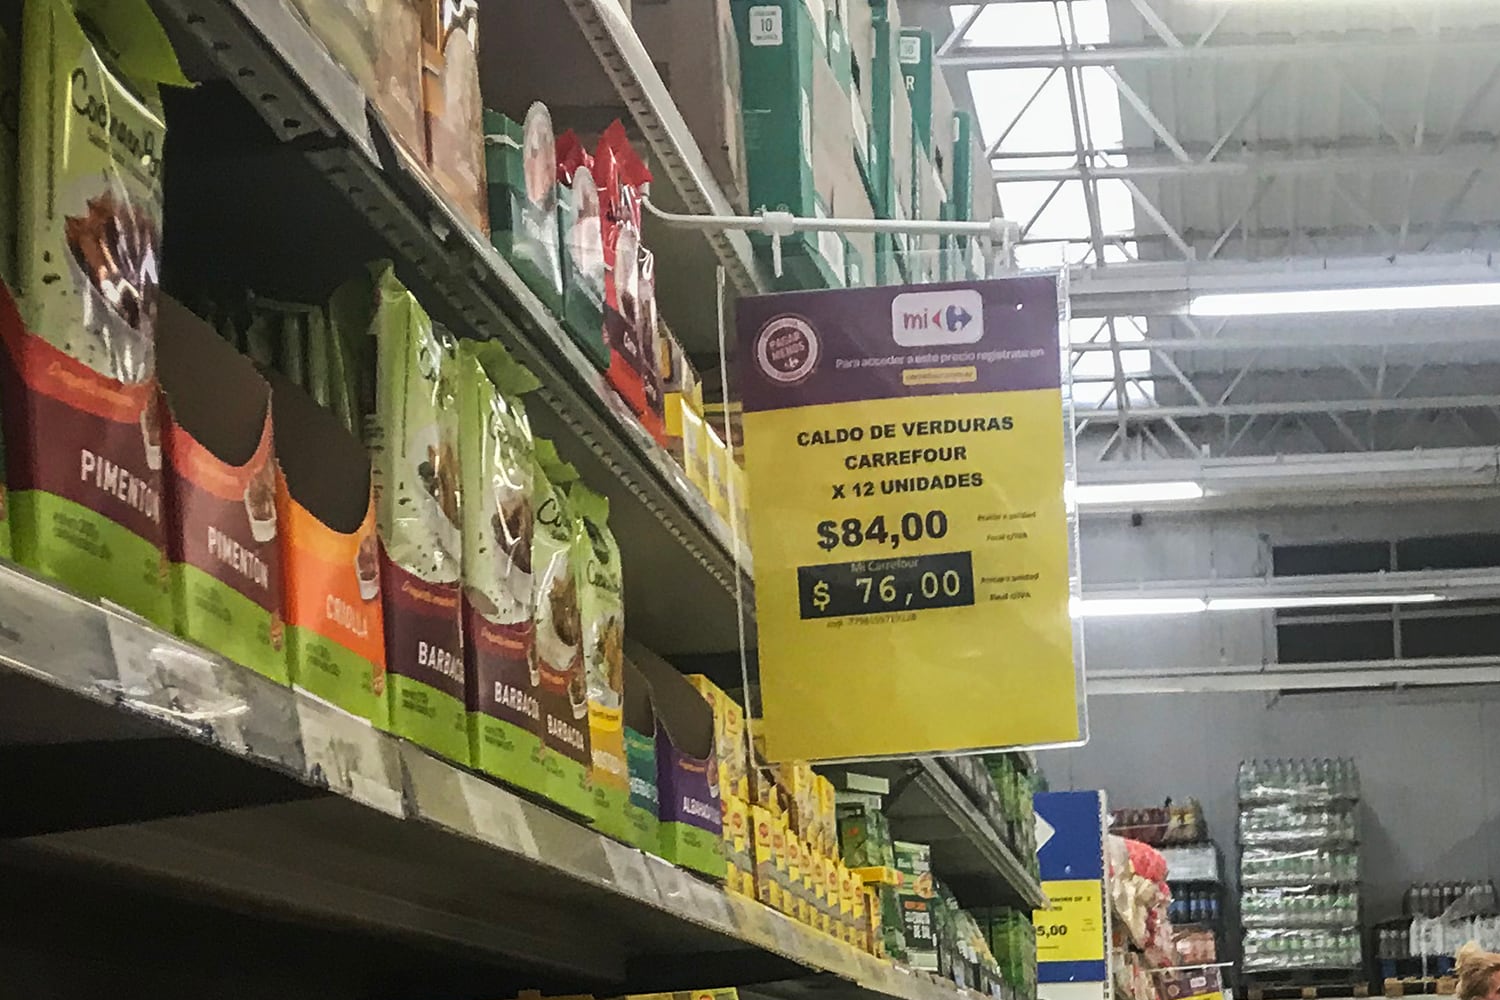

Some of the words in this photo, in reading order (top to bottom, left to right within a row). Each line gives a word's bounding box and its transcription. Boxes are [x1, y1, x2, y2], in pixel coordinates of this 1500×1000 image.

[761, 17, 773, 32] 10
[903, 309, 928, 330] mi
[836, 357, 861, 369] Para
[940, 350, 975, 364] precio
[797, 425, 865, 448] CALDO
[870, 423, 896, 441] DE
[902, 415, 1015, 439] VERDURAS
[844, 446, 968, 471] CARREFOUR
[831, 484, 847, 499] X
[852, 481, 875, 498] 12
[880, 471, 984, 495] UNIDADES
[817, 509, 949, 552] $84,00
[867, 557, 920, 572] Carrefour
[812, 580, 831, 612] $
[855, 569, 961, 607] 76,00
